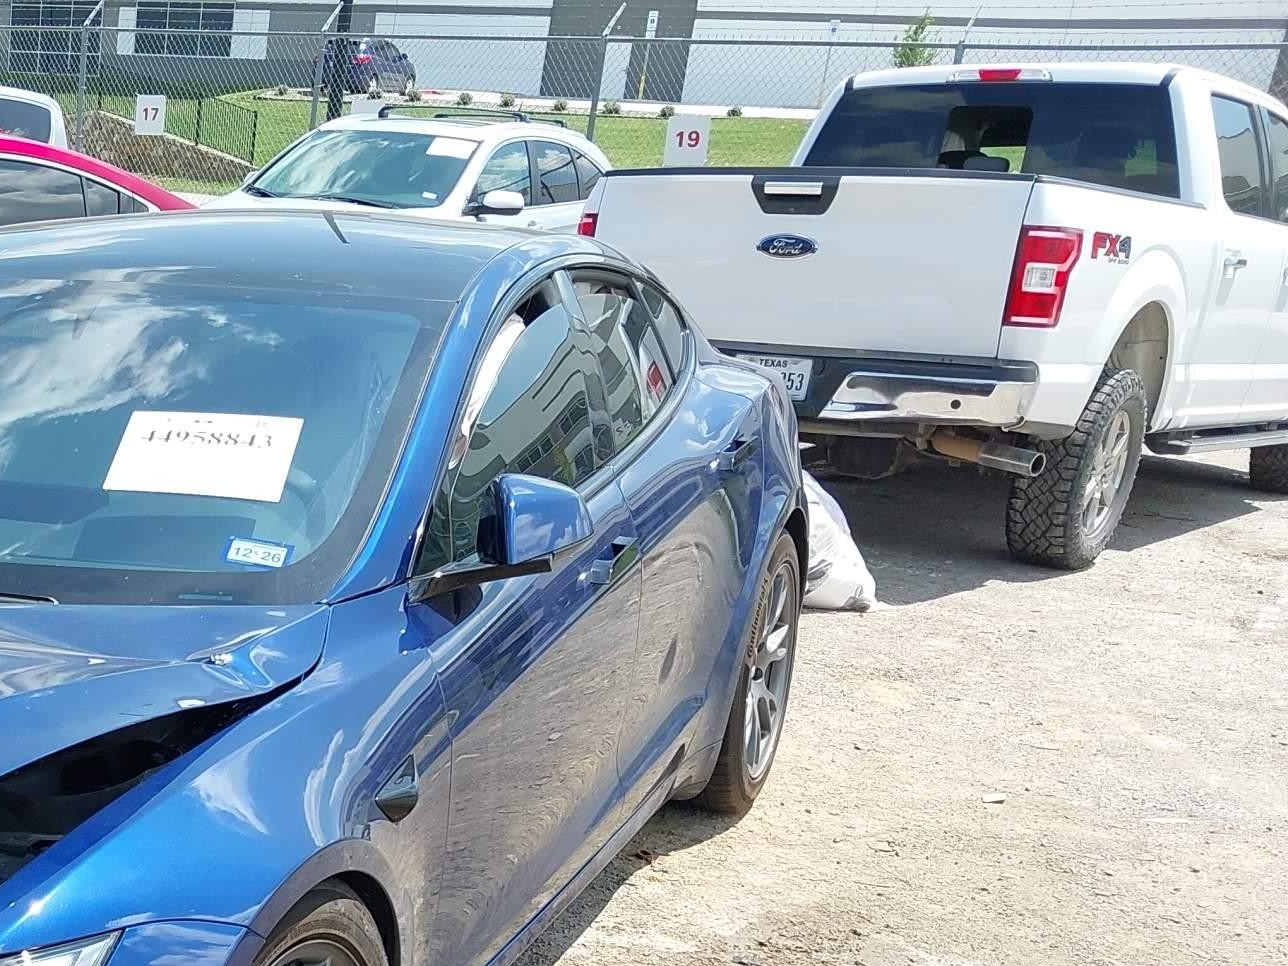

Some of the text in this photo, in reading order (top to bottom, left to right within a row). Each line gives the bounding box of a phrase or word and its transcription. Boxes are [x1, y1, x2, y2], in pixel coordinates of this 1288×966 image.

[142, 107, 160, 121] 17
[675, 130, 701, 148] 19
[769, 238, 803, 254] Ford
[1090, 231, 1132, 260] FX4
[759, 358, 789, 368] TEXAS
[141, 429, 273, 448] 44958843
[233, 547, 282, 563] 12 26
